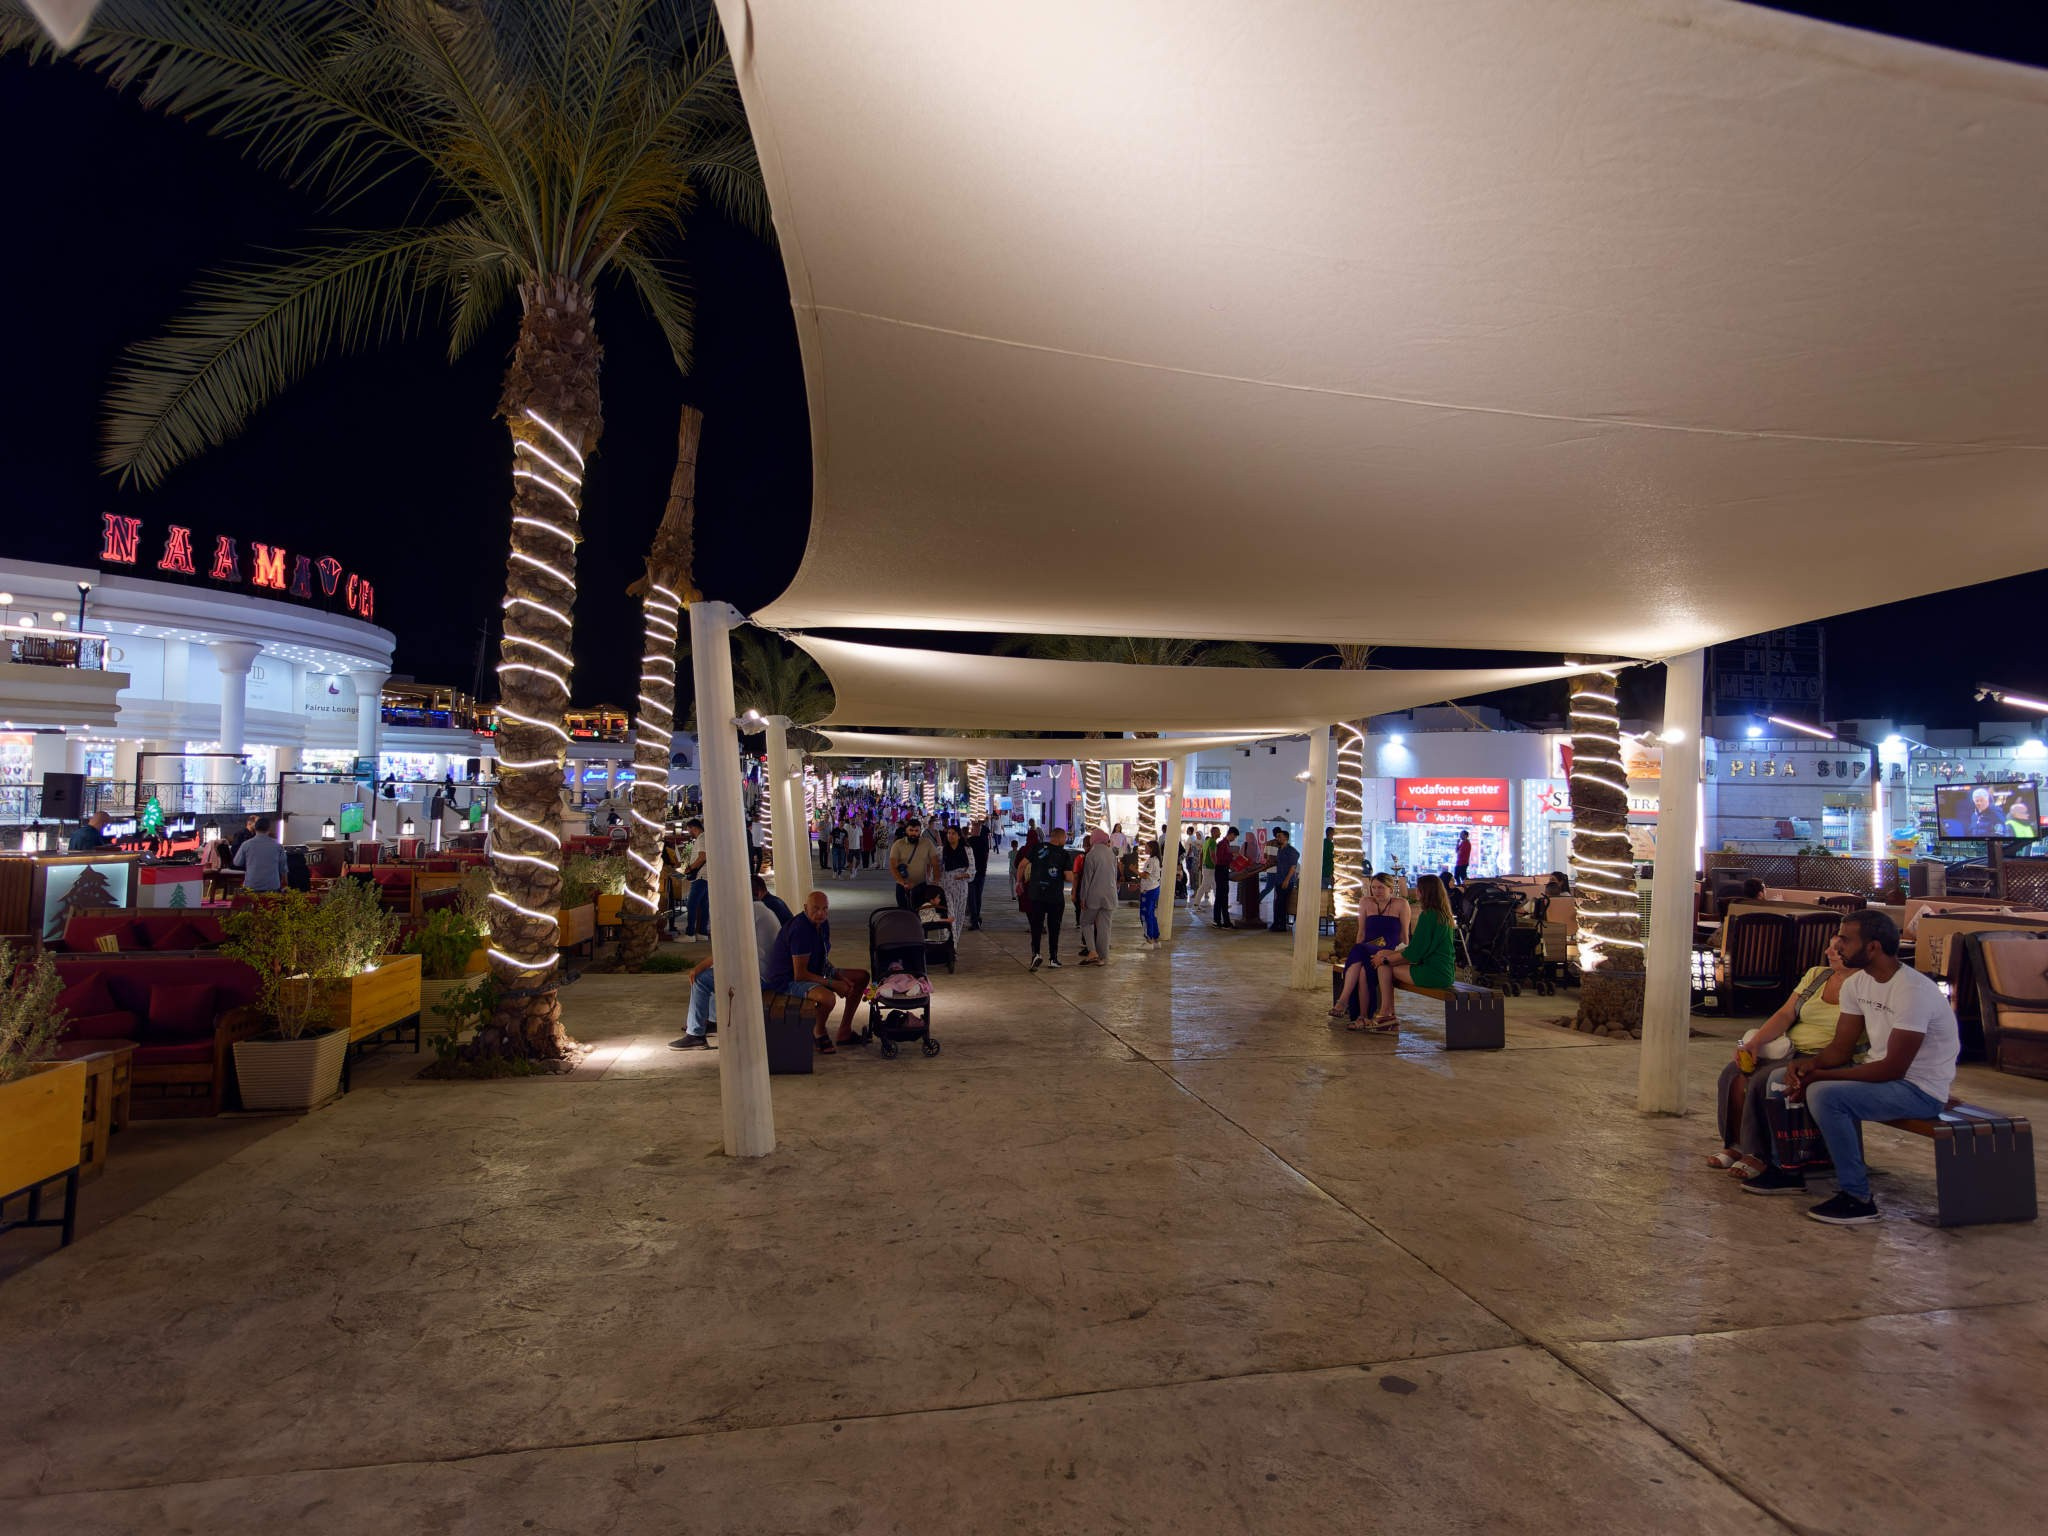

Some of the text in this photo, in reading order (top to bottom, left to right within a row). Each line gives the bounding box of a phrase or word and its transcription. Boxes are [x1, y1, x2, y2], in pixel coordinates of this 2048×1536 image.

[1743, 649, 1797, 673] PISA
[1719, 673, 1819, 698] MERCATO
[305, 704, 330, 712] Fairuz
[1730, 759, 1798, 777] PISA
[1916, 762, 1968, 778] PISA
[1408, 784, 1500, 795] vodafone center
[1481, 814, 1494, 823] 4G
